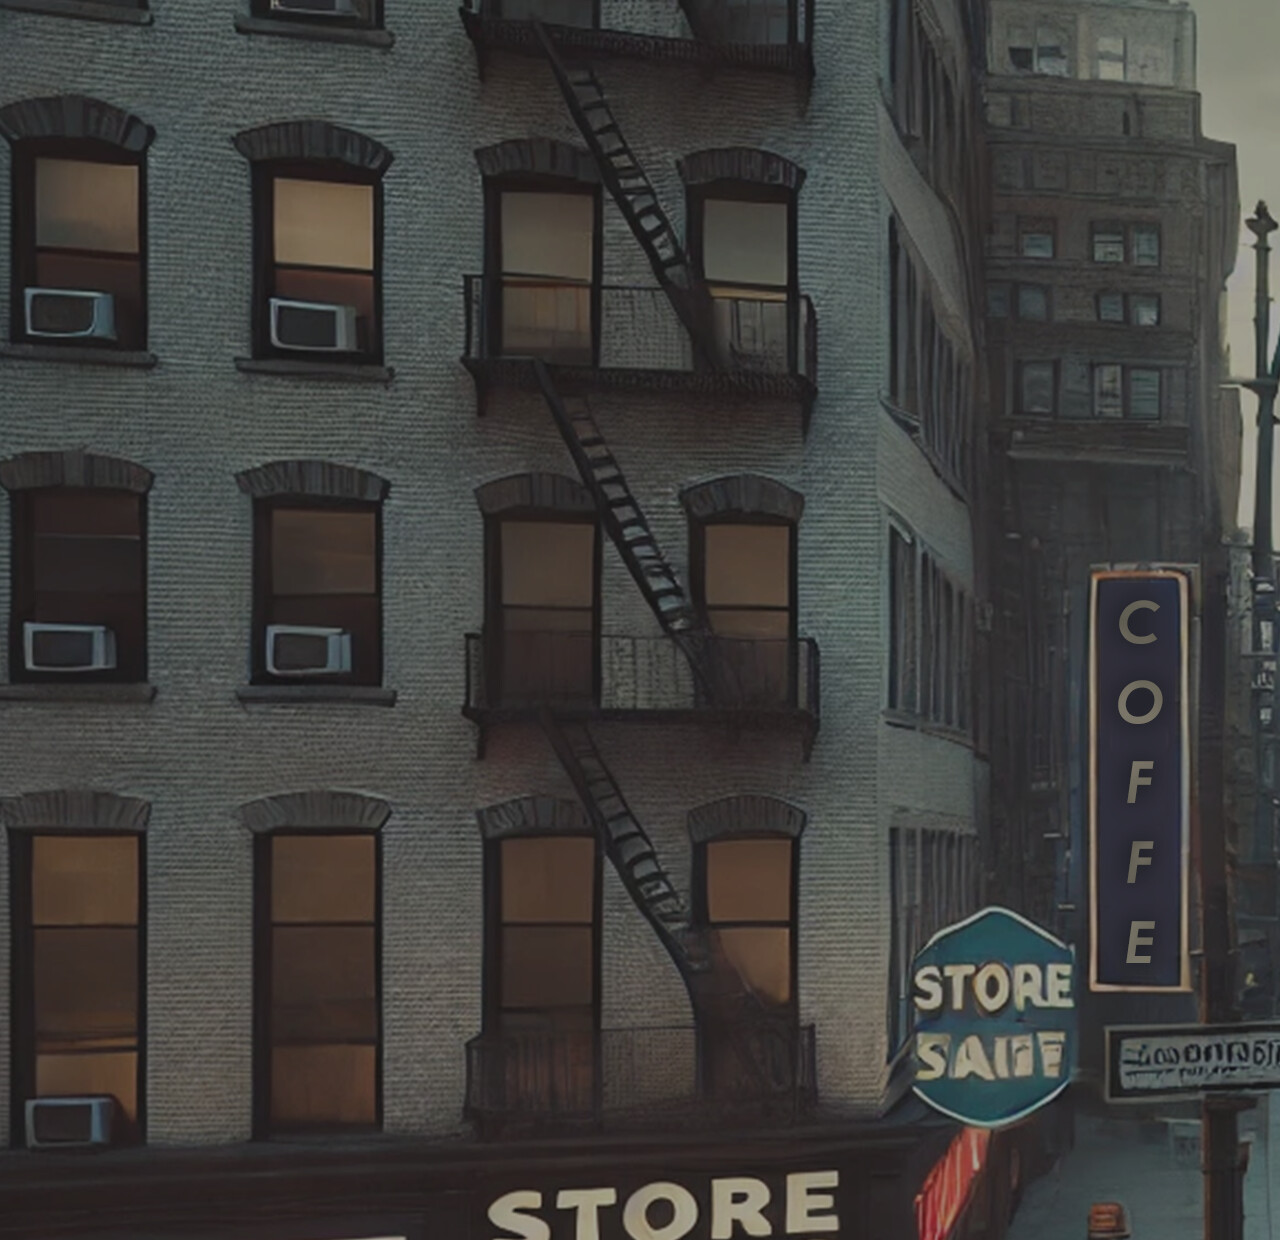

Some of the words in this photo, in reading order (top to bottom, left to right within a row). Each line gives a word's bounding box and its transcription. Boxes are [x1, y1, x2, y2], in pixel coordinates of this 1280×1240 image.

[1118, 599, 1164, 964] COFFE
[914, 963, 1075, 1012] STORE
[487, 1170, 839, 1240] STORE
